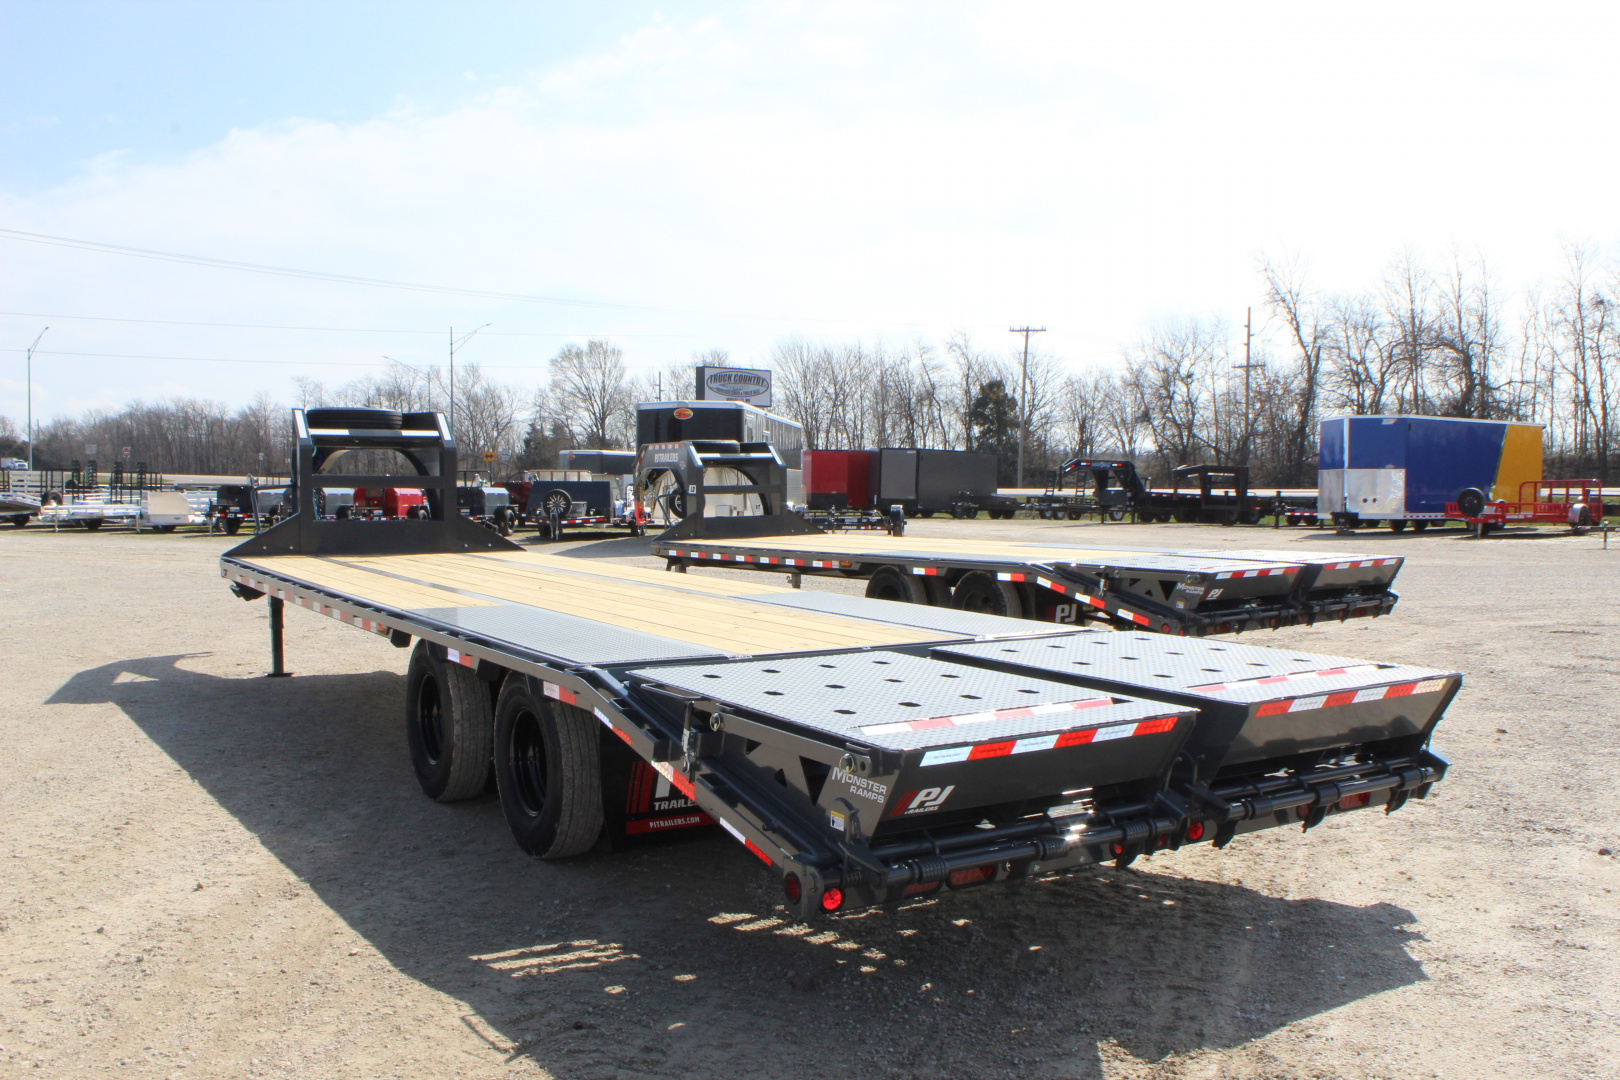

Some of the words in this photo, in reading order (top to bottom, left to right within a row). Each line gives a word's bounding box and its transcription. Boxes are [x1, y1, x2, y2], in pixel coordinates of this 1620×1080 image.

[709, 374, 733, 384] TRUCK
[733, 374, 766, 385] COUNTRY
[1176, 582, 1205, 592] MONSTER
[1055, 603, 1078, 623] PJ
[832, 766, 887, 795] MONSTER
[849, 785, 885, 804] RAMPS
[908, 785, 955, 809] PJ
[653, 798, 697, 811] TRAILE
[649, 816, 700, 829] PJTRAILERS.COM
